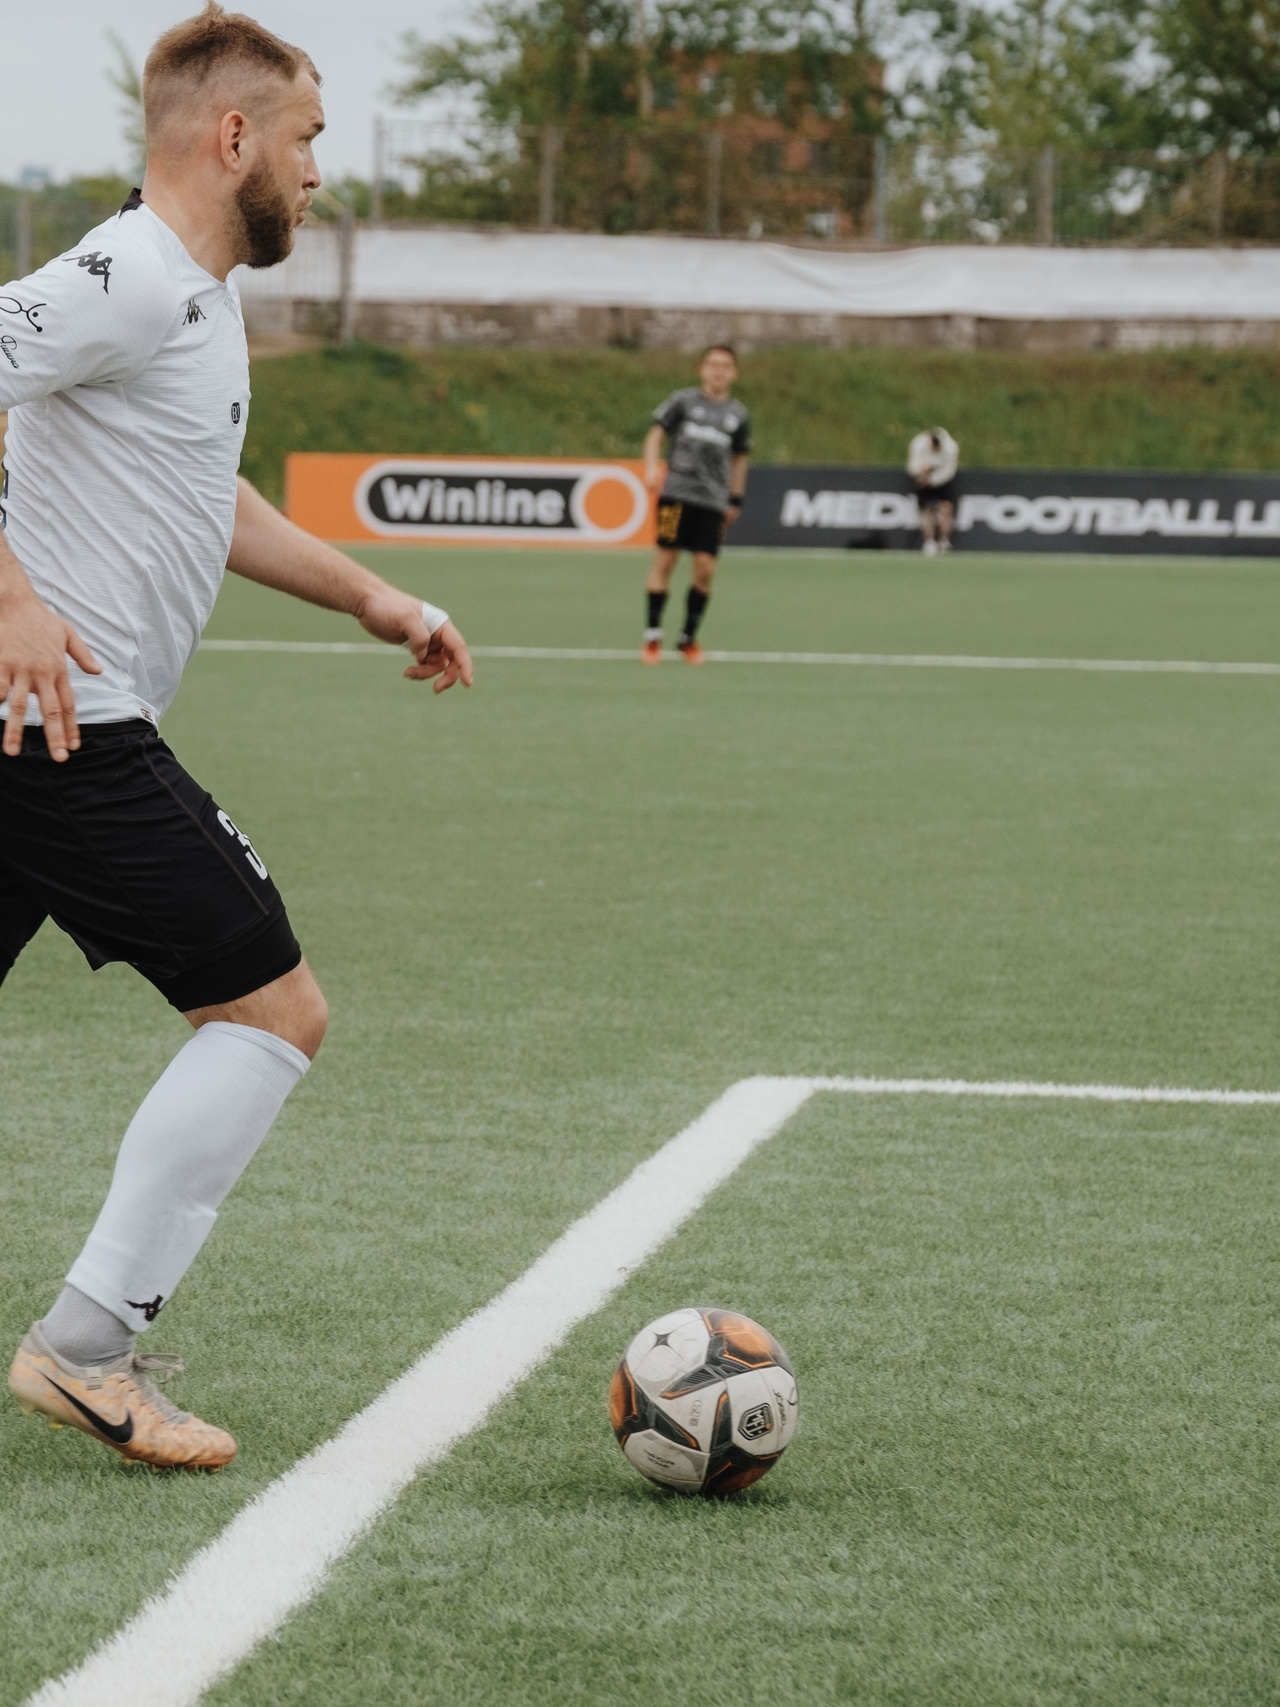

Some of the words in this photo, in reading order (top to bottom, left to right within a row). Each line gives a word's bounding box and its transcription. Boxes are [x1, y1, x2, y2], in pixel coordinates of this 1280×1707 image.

[380, 477, 566, 526] Winline
[780, 489, 920, 530] MEDI
[954, 495, 1232, 538] FOOTBALL
